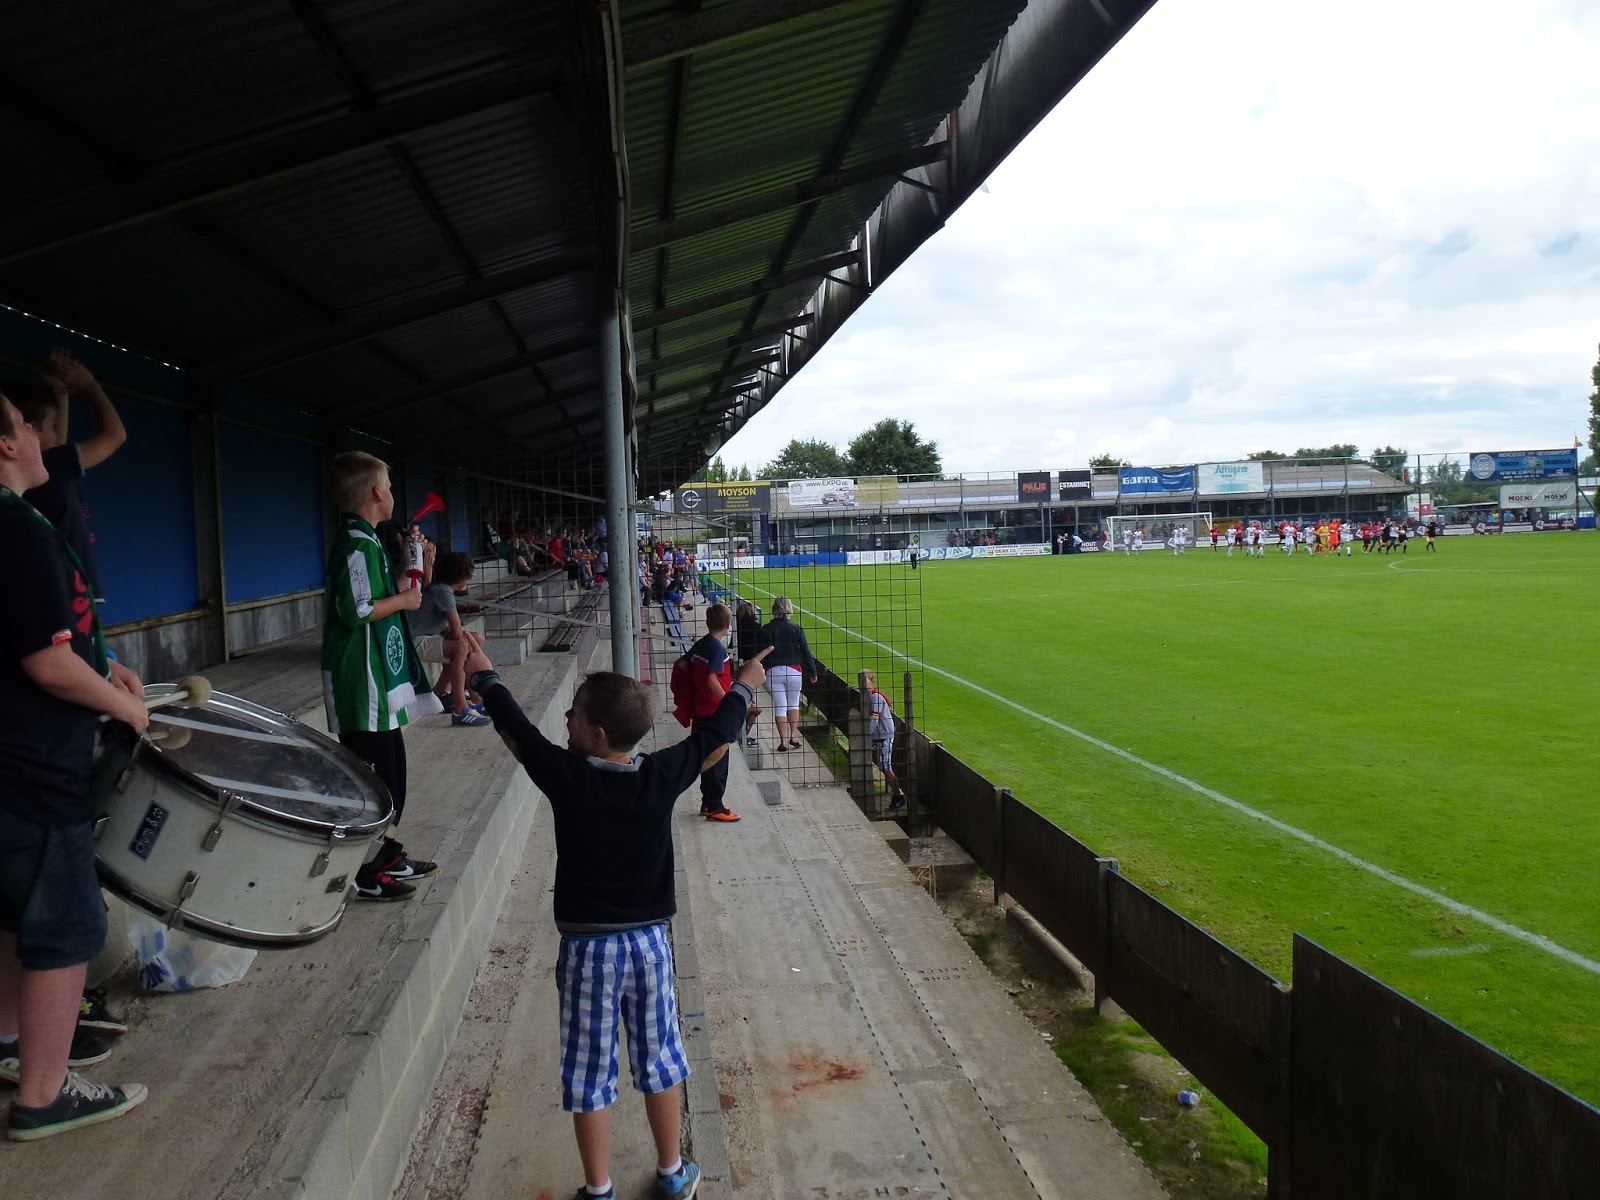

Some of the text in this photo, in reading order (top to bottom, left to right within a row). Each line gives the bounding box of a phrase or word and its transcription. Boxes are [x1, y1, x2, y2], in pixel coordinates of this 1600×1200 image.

[1214, 464, 1248, 475] Affligem
[1059, 481, 1091, 490] ESTAMINET
[717, 487, 757, 497] MOYSON
